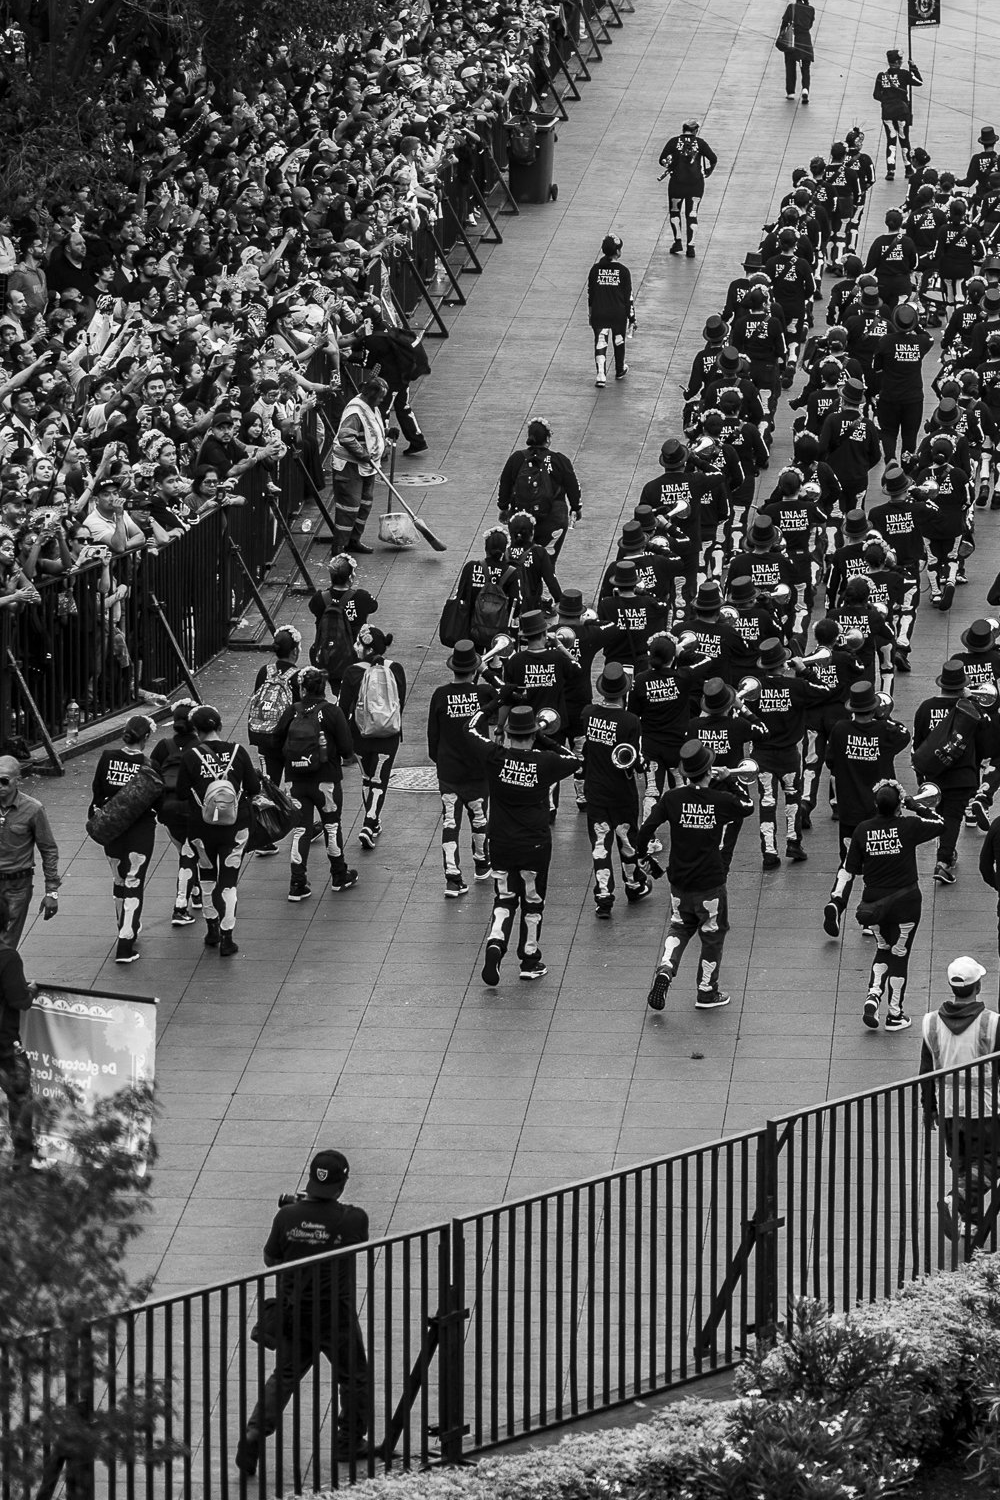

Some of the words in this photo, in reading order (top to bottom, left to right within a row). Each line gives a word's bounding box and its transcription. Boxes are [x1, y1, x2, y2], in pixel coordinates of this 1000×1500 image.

[598, 268, 620, 276] LINAJE
[896, 344, 920, 352] LINAJE
[894, 352, 921, 360] AZTECA
[662, 482, 690, 493] LINAJE
[660, 491, 692, 502] AZTECA
[780, 510, 807, 519] LINAJE
[886, 512, 912, 524] LINAJE
[780, 518, 809, 527] AZTECA
[886, 520, 914, 533] AZTECA
[752, 563, 779, 573] LINAJE
[752, 573, 780, 582] AZTECA
[838, 615, 868, 625] LINAJE
[525, 664, 555, 674] LINAJE
[964, 662, 992, 674] LINAJE
[524, 674, 556, 684] AZTECA
[646, 677, 676, 691] LINAJE
[447, 693, 478, 704] LINAJE
[646, 686, 680, 700] AZTECA
[760, 689, 790, 699] LINAJE
[759, 698, 792, 708] AZTECA
[447, 703, 481, 715] AZTECA
[930, 708, 950, 718] LINA
[588, 717, 617, 731] LINAJE
[586, 727, 617, 742] AZTECA
[698, 730, 728, 740] LINAJE
[702, 740, 732, 750] ZTECA
[848, 735, 879, 746] LINAJE
[845, 745, 880, 756] AZTECA
[109, 760, 140, 774] LINAJE
[504, 759, 537, 773] LINAJE
[499, 770, 539, 783] AZTECA
[682, 803, 715, 814] LINAJE
[679, 813, 717, 825] AZTECA
[867, 828, 899, 841] LINAJE
[866, 839, 903, 852] AZTECA
